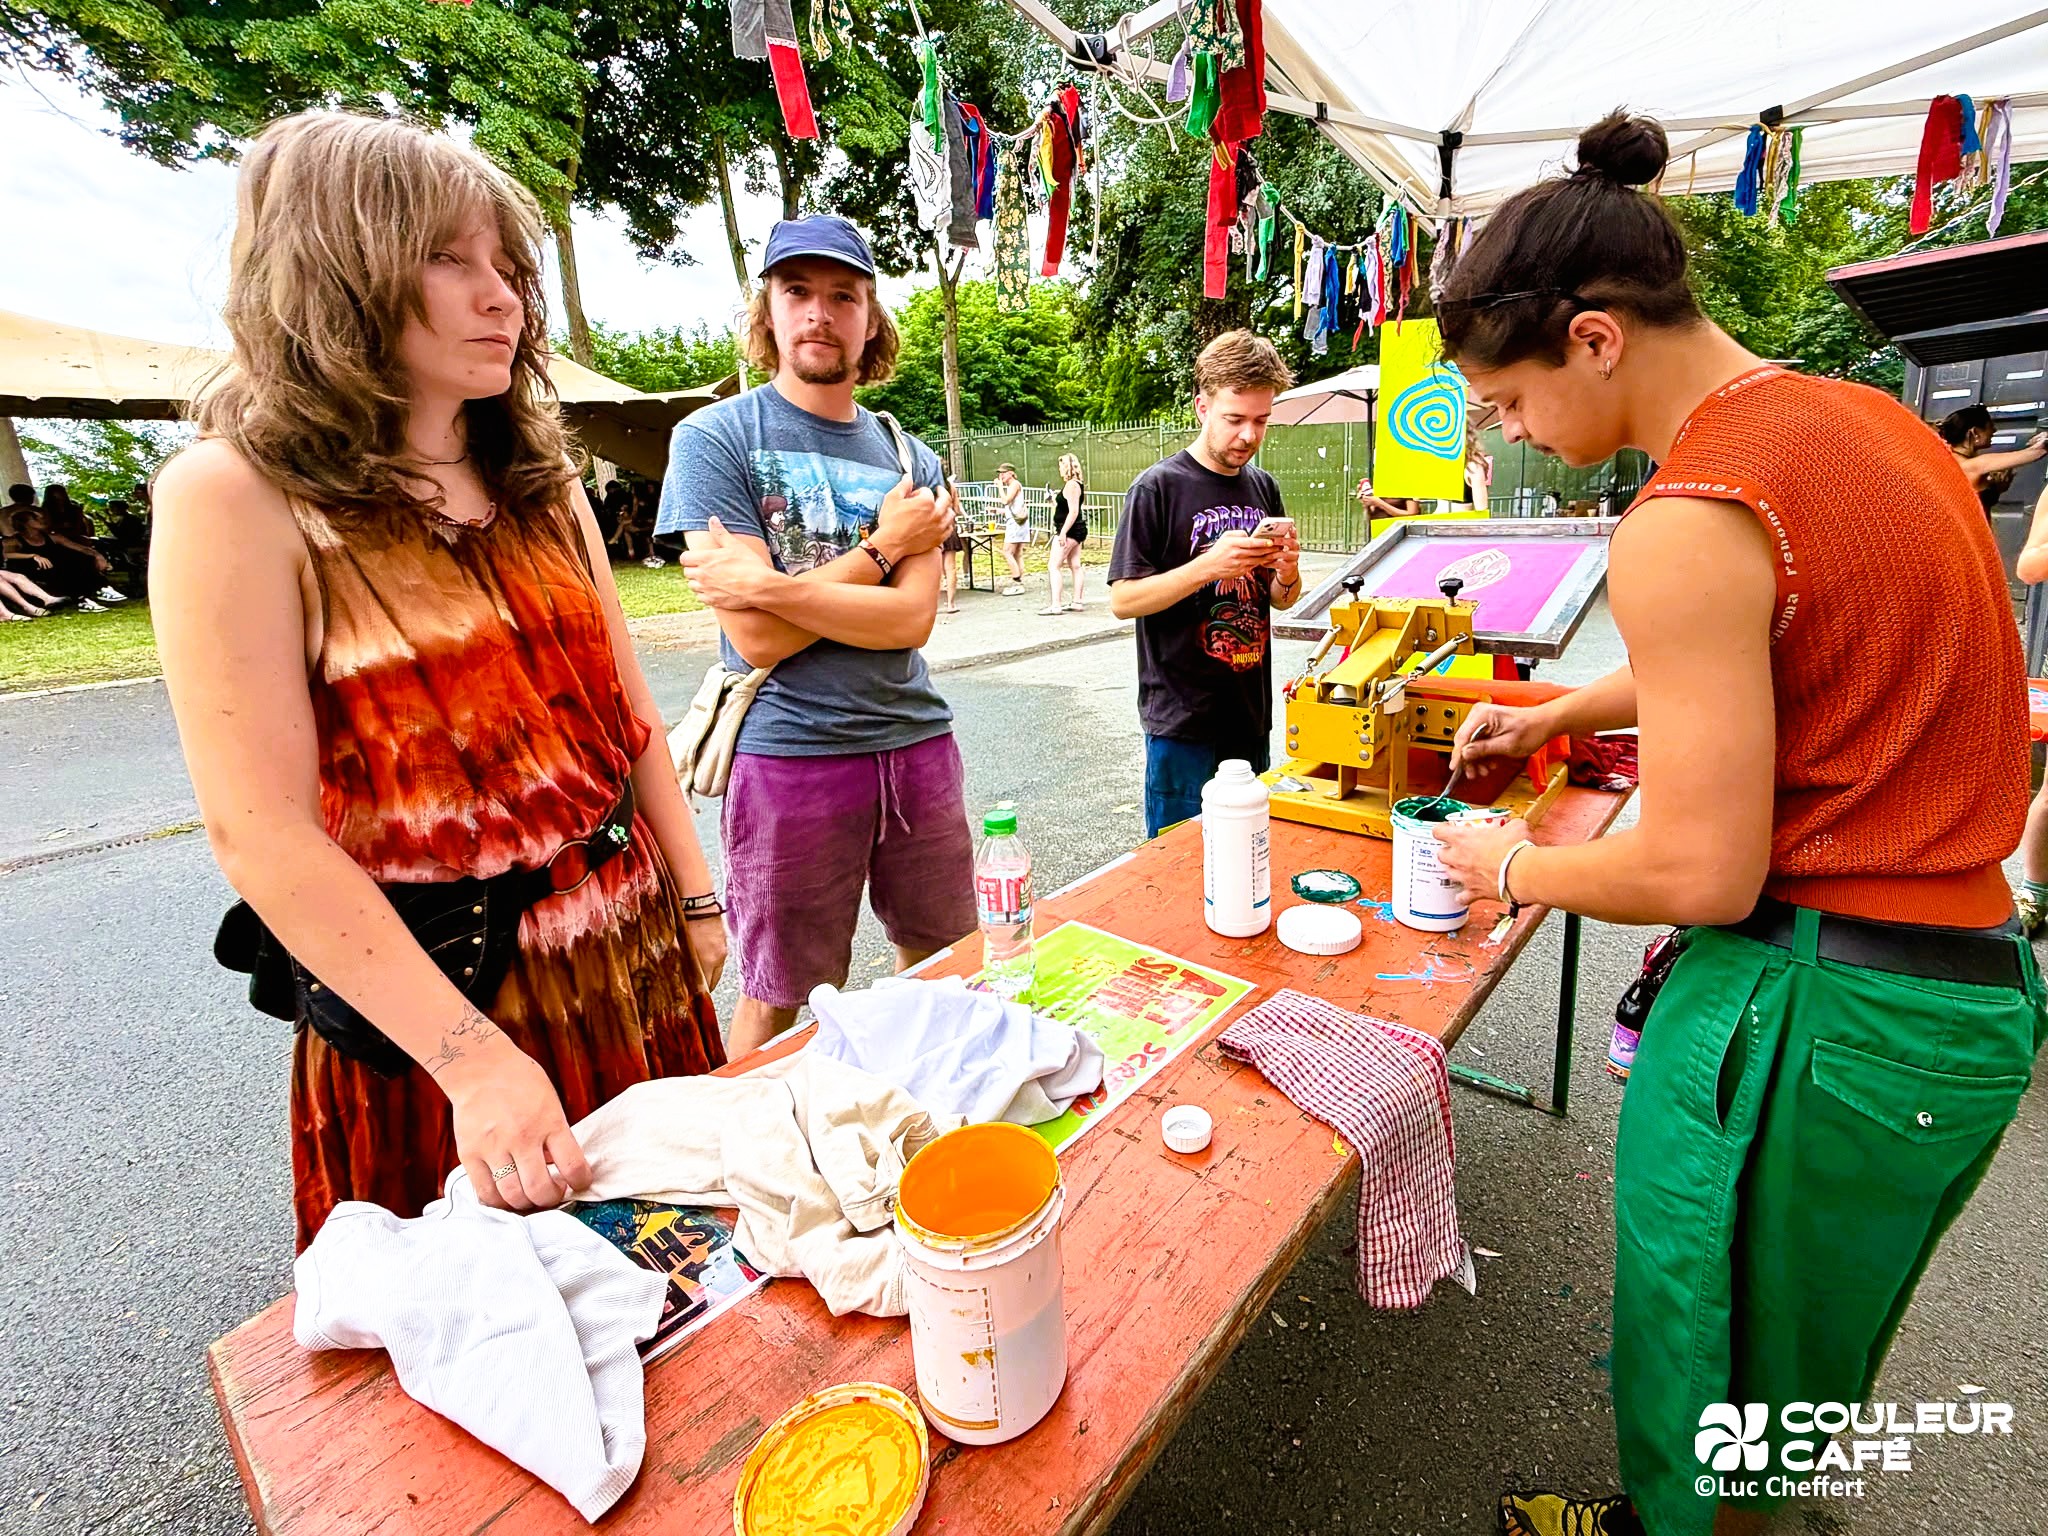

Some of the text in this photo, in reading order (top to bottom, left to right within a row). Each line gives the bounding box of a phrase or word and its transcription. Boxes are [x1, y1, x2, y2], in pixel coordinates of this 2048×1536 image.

[1655, 481, 1743, 495] renoma
[1190, 505, 1266, 556] PARADO
[1758, 498, 1798, 577] renoma
[1088, 956, 1178, 1021] SHOW
[1144, 968, 1228, 1036] ART
